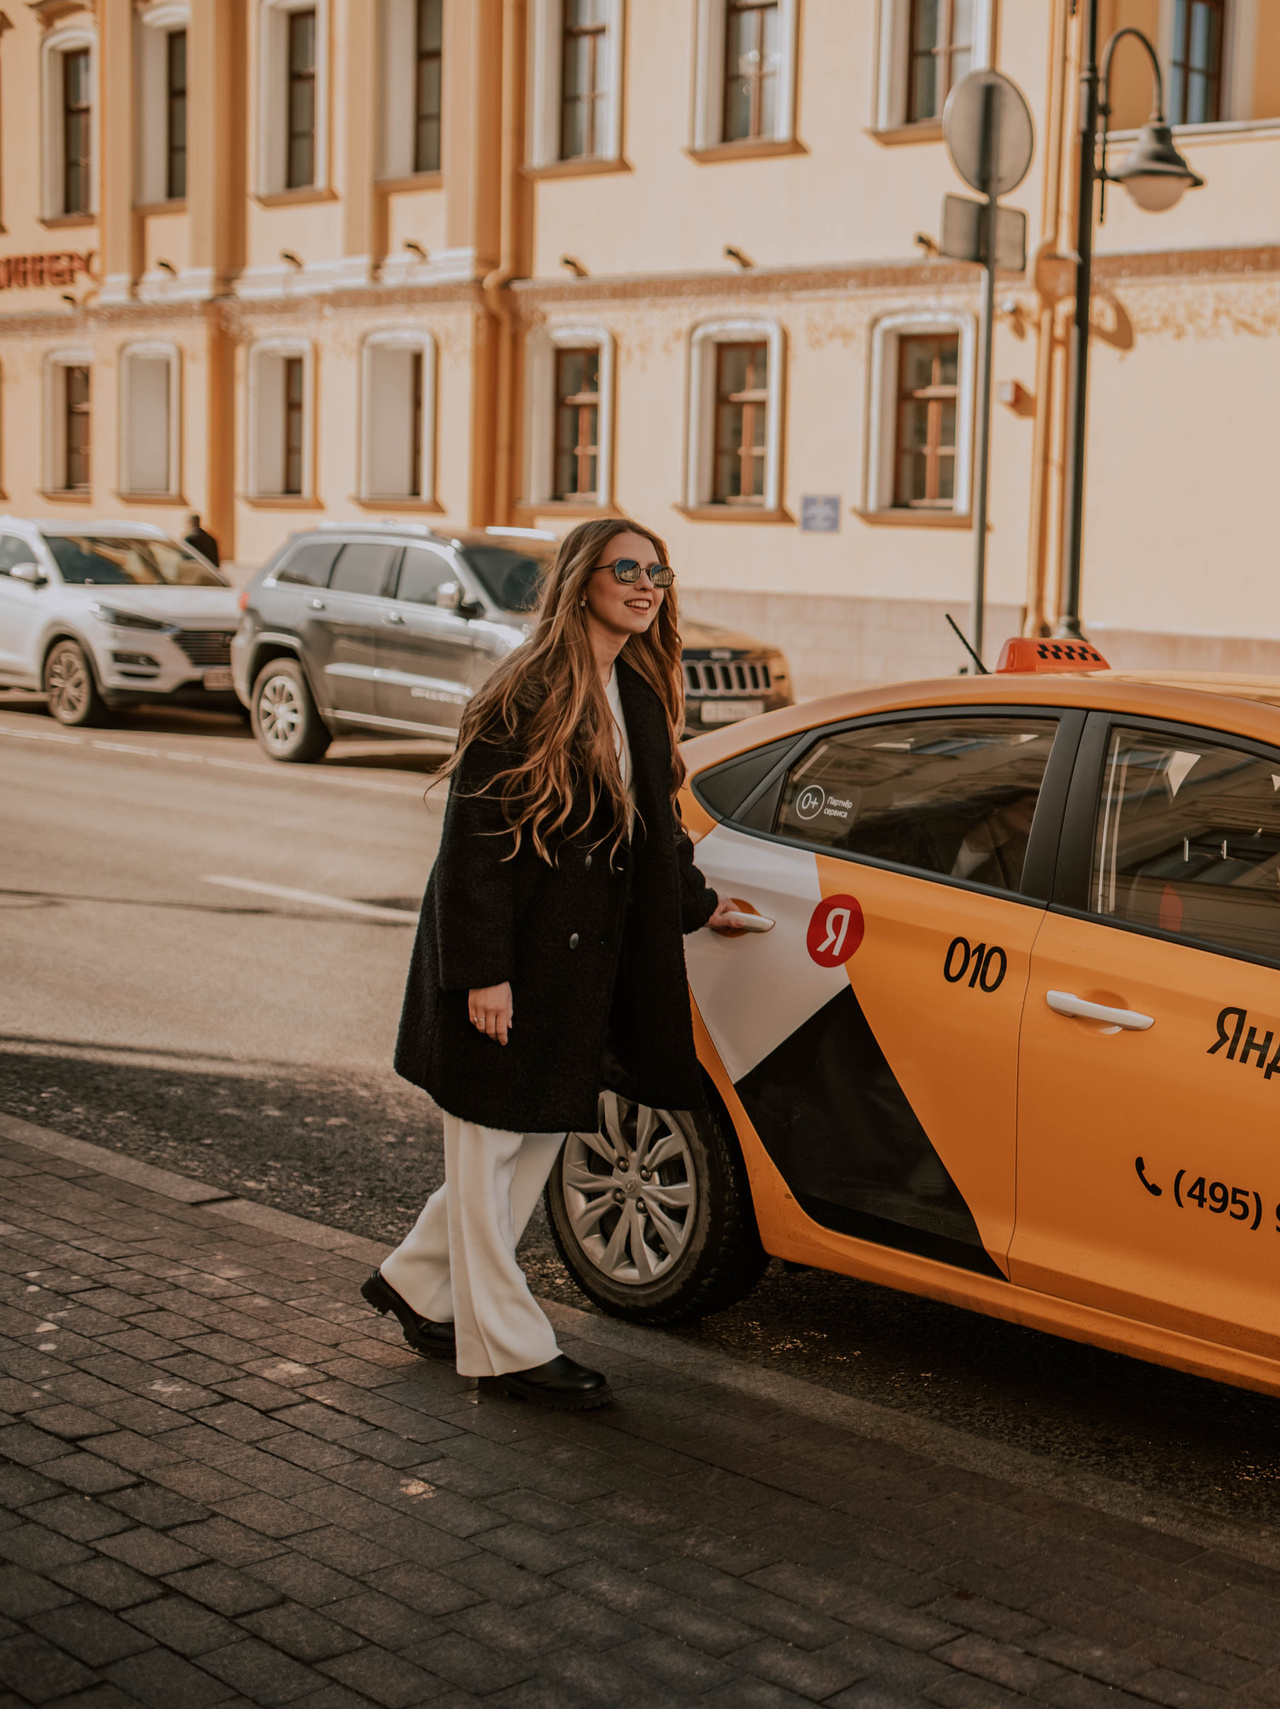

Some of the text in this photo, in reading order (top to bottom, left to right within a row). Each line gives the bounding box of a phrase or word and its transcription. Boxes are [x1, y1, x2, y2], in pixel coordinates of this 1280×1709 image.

[816, 907, 851, 957] Я
[943, 936, 1007, 993] 010
[1173, 1169, 1263, 1231] (495)
